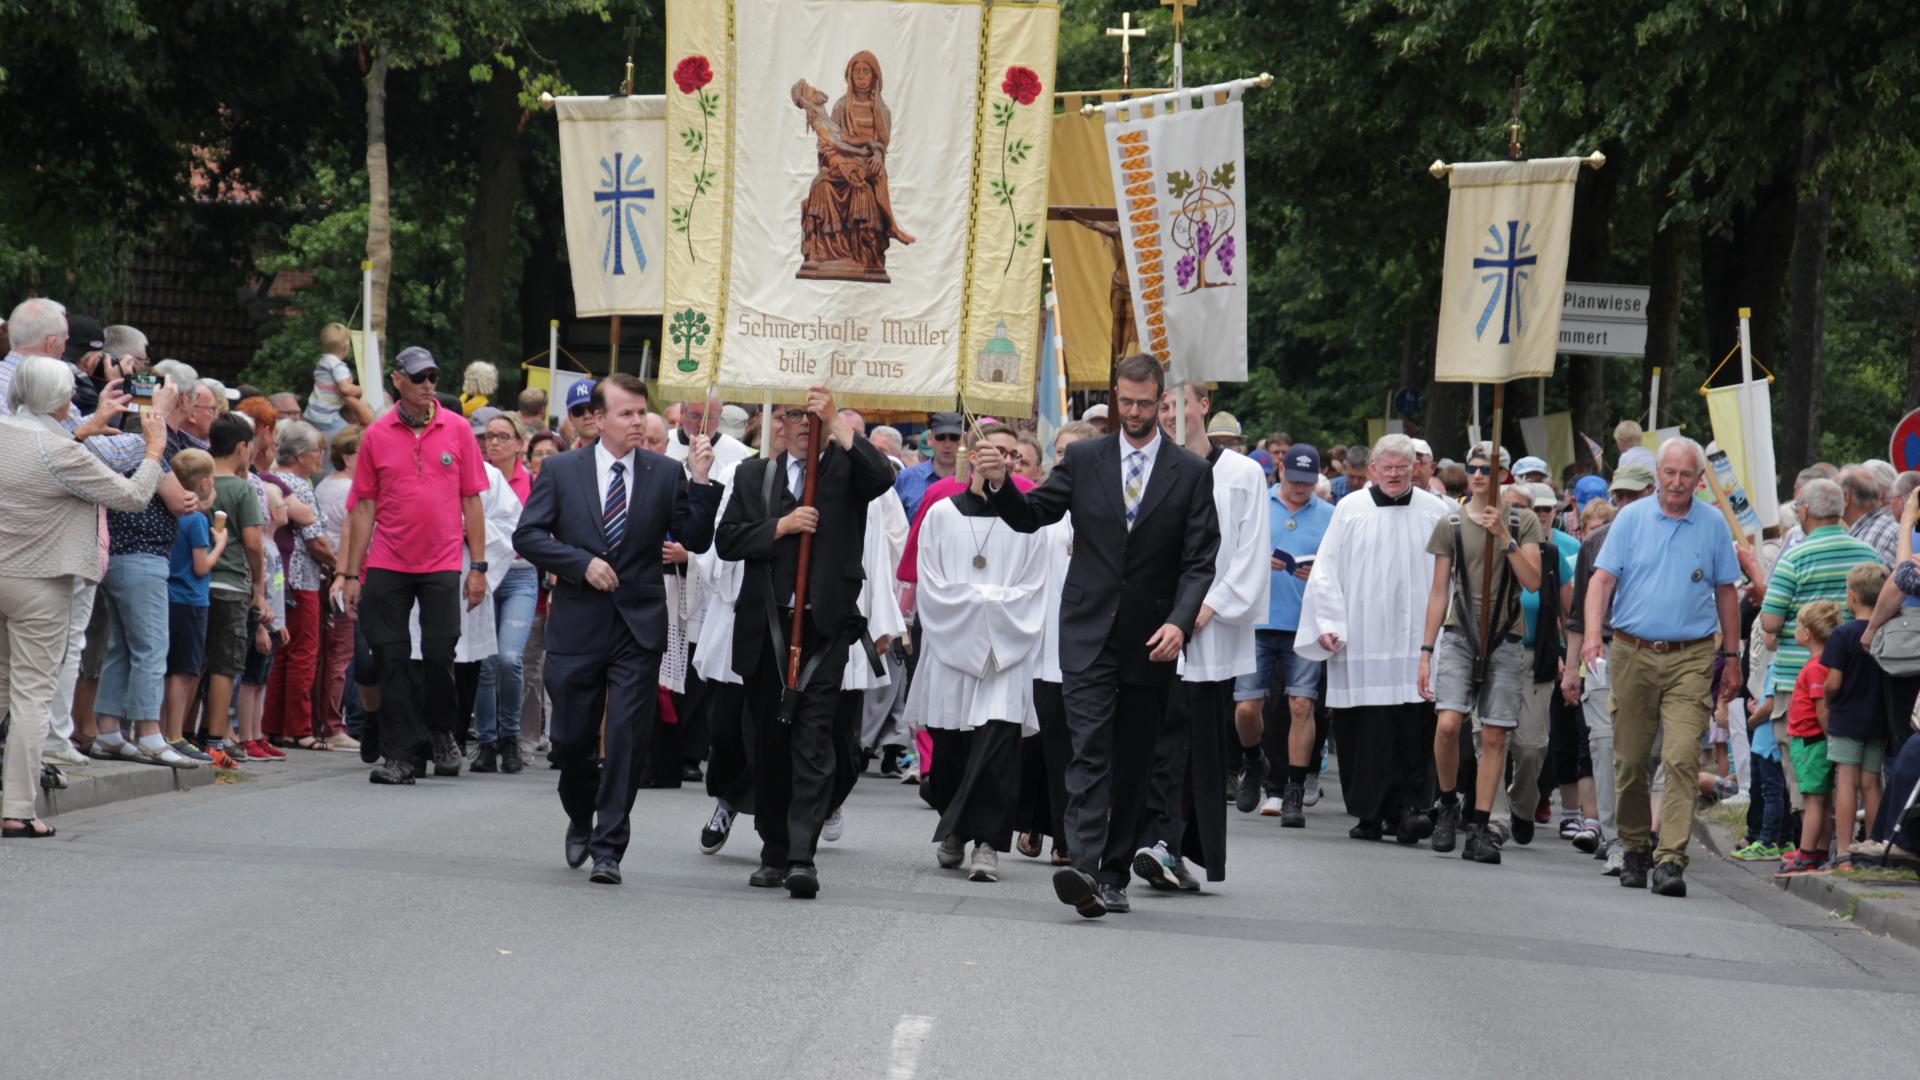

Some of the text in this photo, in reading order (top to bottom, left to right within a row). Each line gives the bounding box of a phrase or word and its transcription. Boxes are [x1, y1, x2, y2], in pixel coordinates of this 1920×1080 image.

[1563, 292, 1642, 312] Planwiese
[1559, 329, 1608, 346] mmert
[830, 350, 857, 378] für
[864, 360, 905, 378] uns
